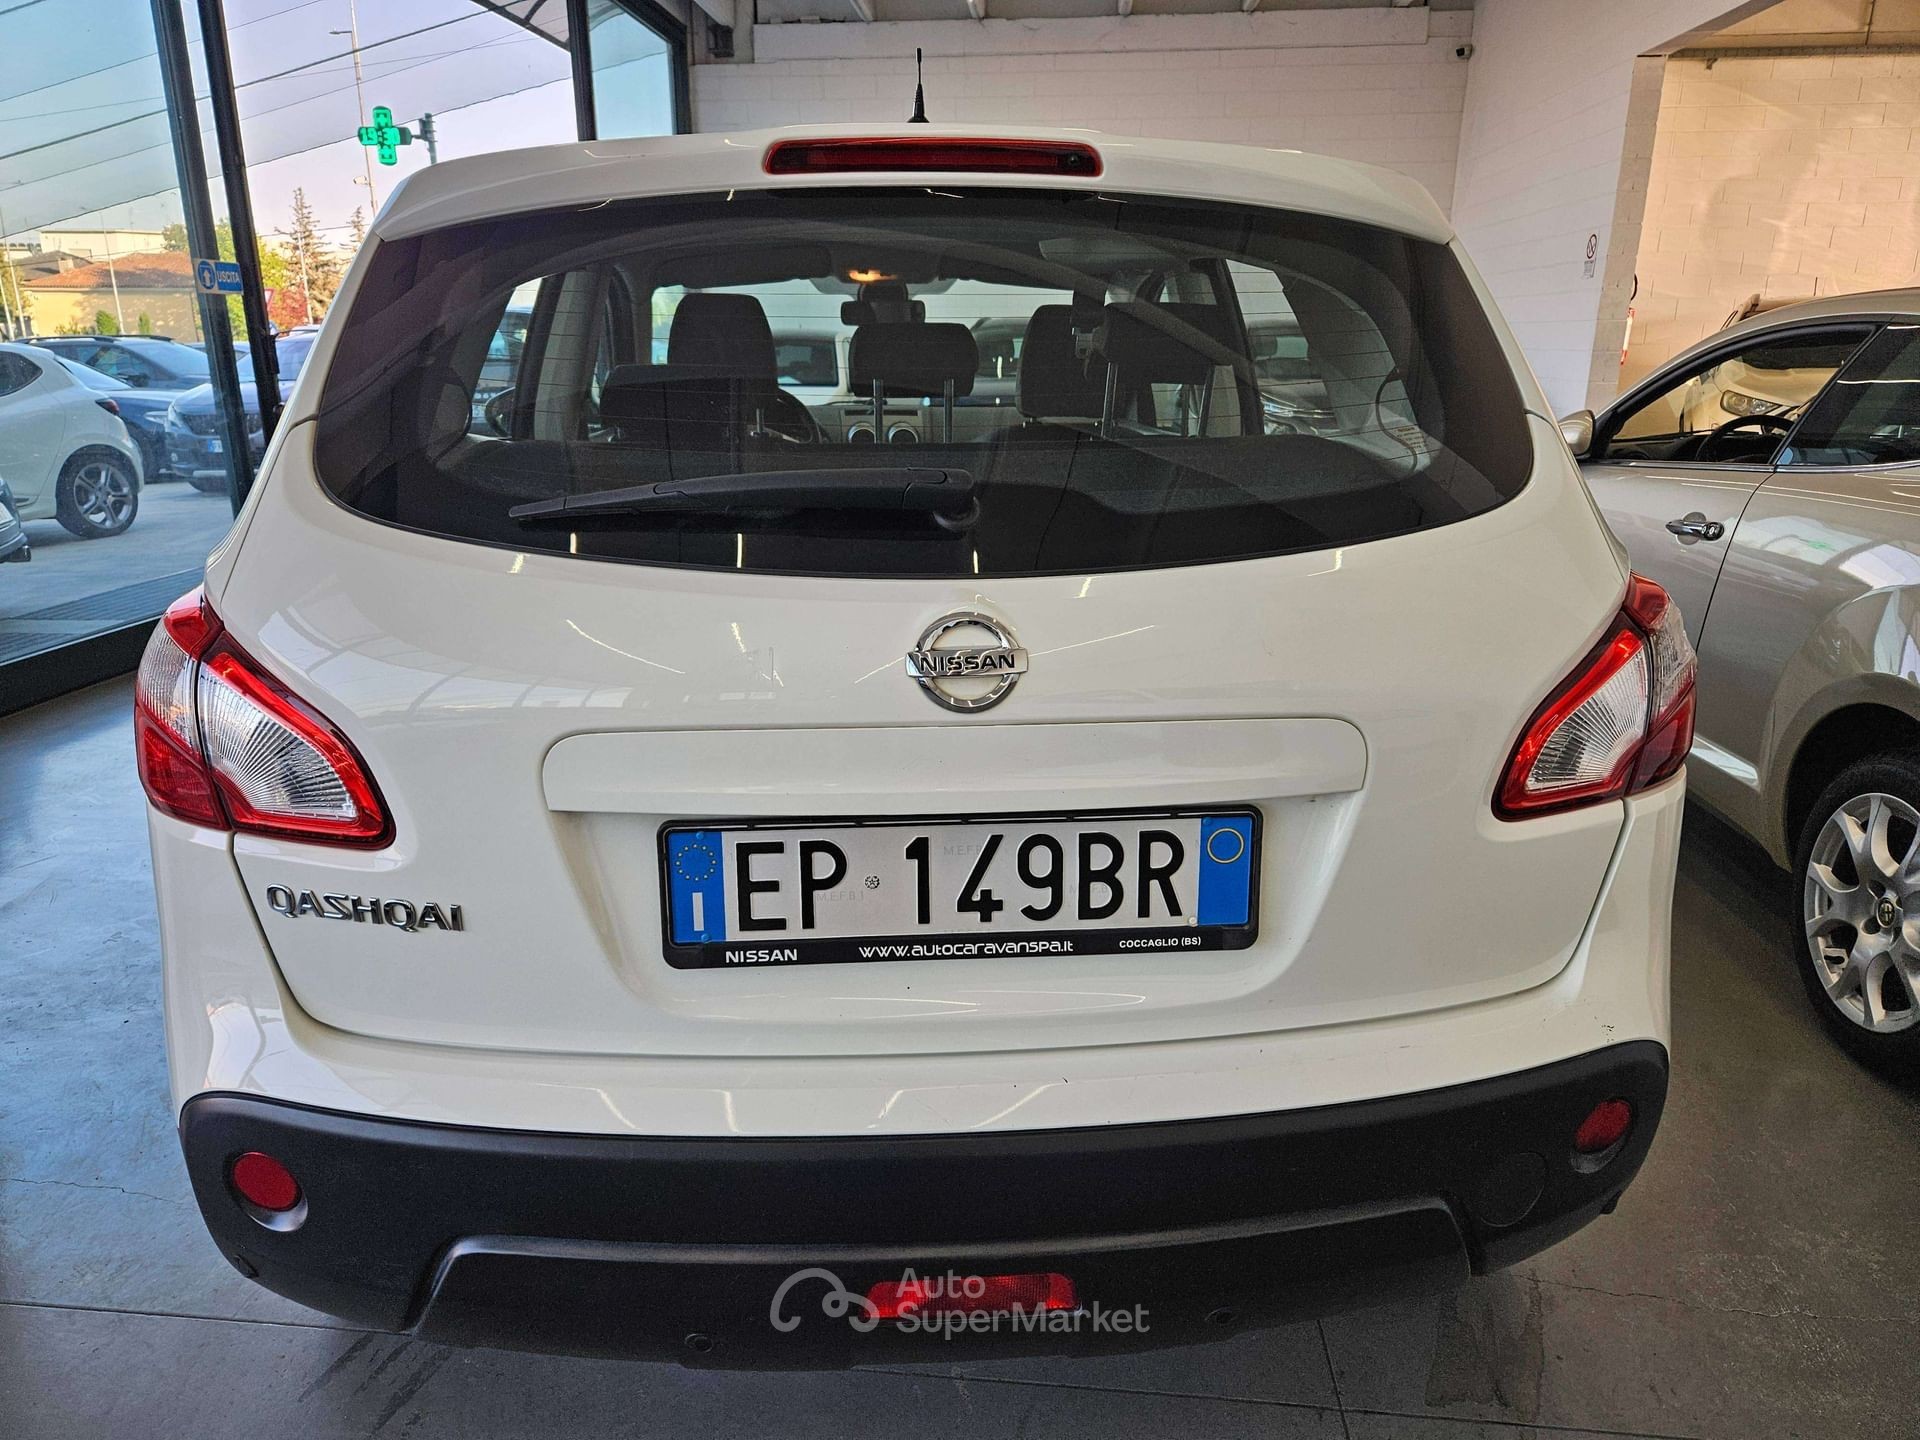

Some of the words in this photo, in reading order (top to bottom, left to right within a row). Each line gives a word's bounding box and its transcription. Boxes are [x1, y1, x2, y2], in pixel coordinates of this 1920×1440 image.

[216, 270, 241, 283] USCITA
[919, 653, 1016, 673] NISSAN
[735, 839, 848, 931] EP
[905, 829, 1185, 925] 149BR
[266, 882, 464, 933] QASHQAI
[1119, 938, 1179, 949] COCCAGLIO
[1181, 936, 1202, 948] (BS)
[725, 948, 798, 964] NISSAN
